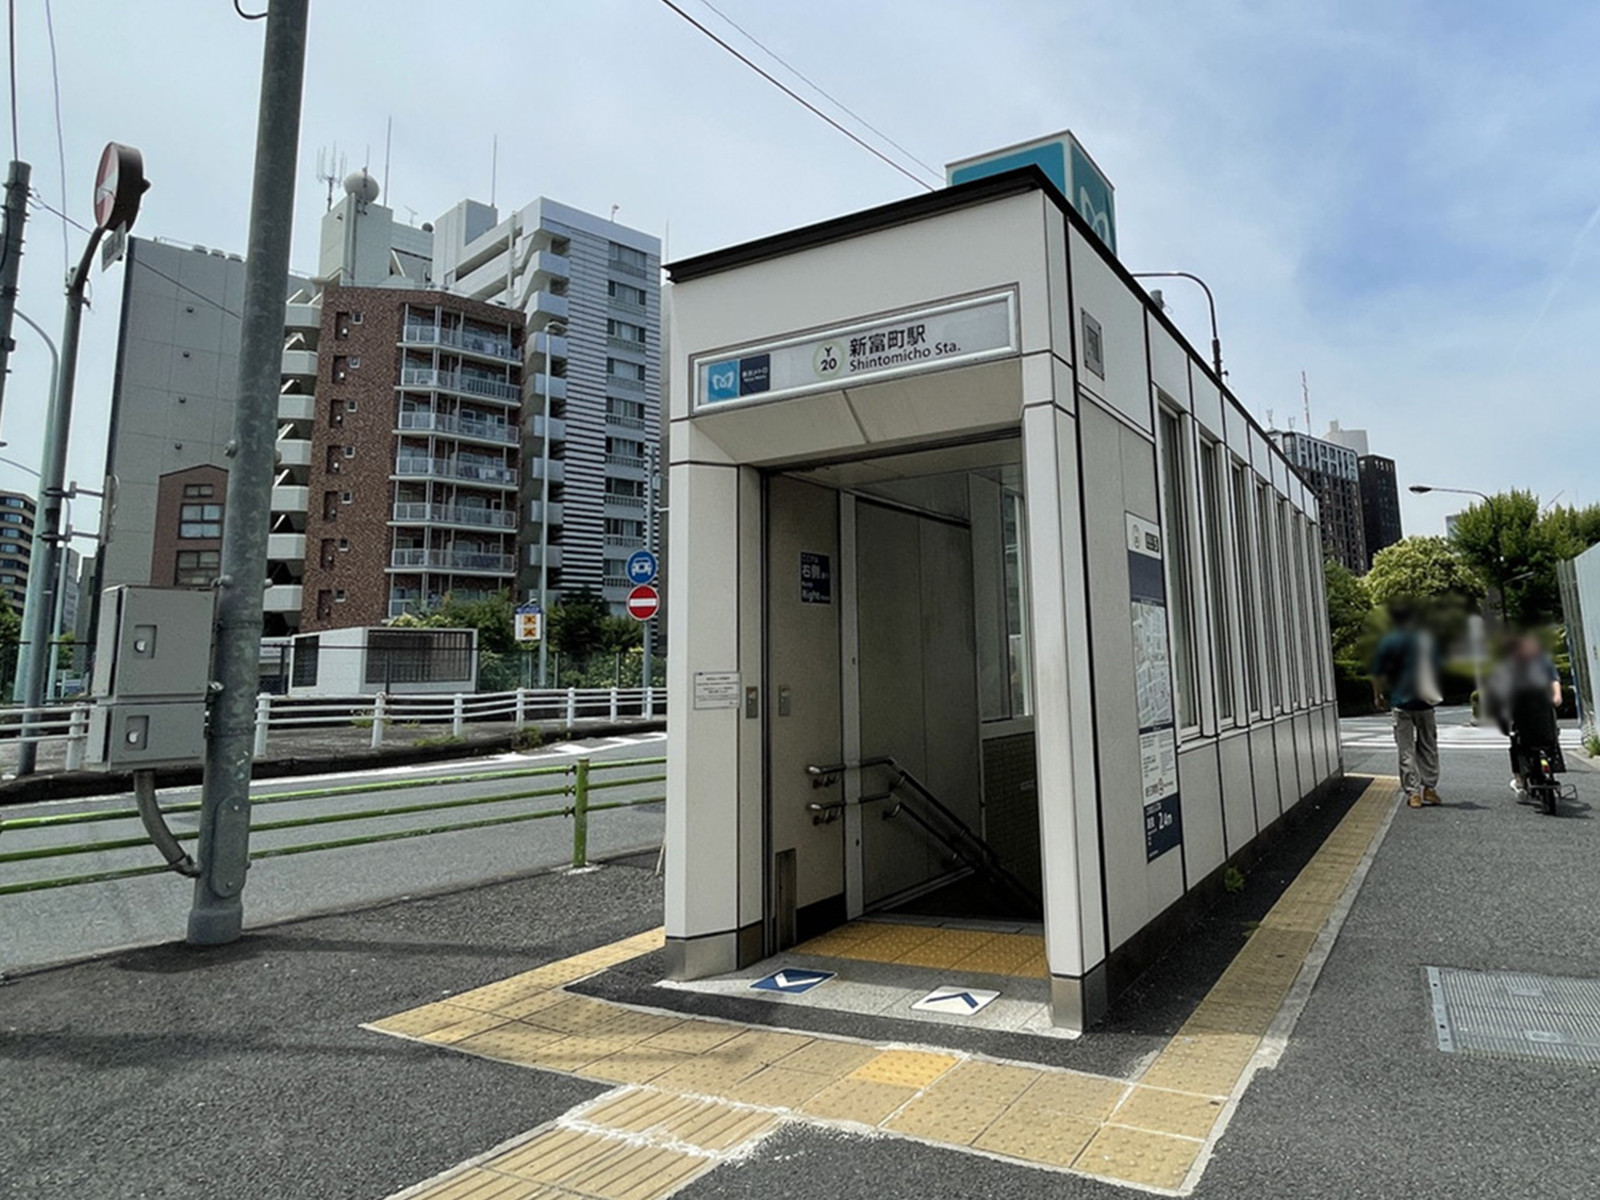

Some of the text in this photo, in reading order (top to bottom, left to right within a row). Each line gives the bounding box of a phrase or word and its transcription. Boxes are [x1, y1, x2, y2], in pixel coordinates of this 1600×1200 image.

[824, 346, 833, 358] Y
[849, 324, 926, 358] 新富町駅
[820, 357, 837, 371] 20
[849, 341, 961, 372] Shintomicho Sta.
